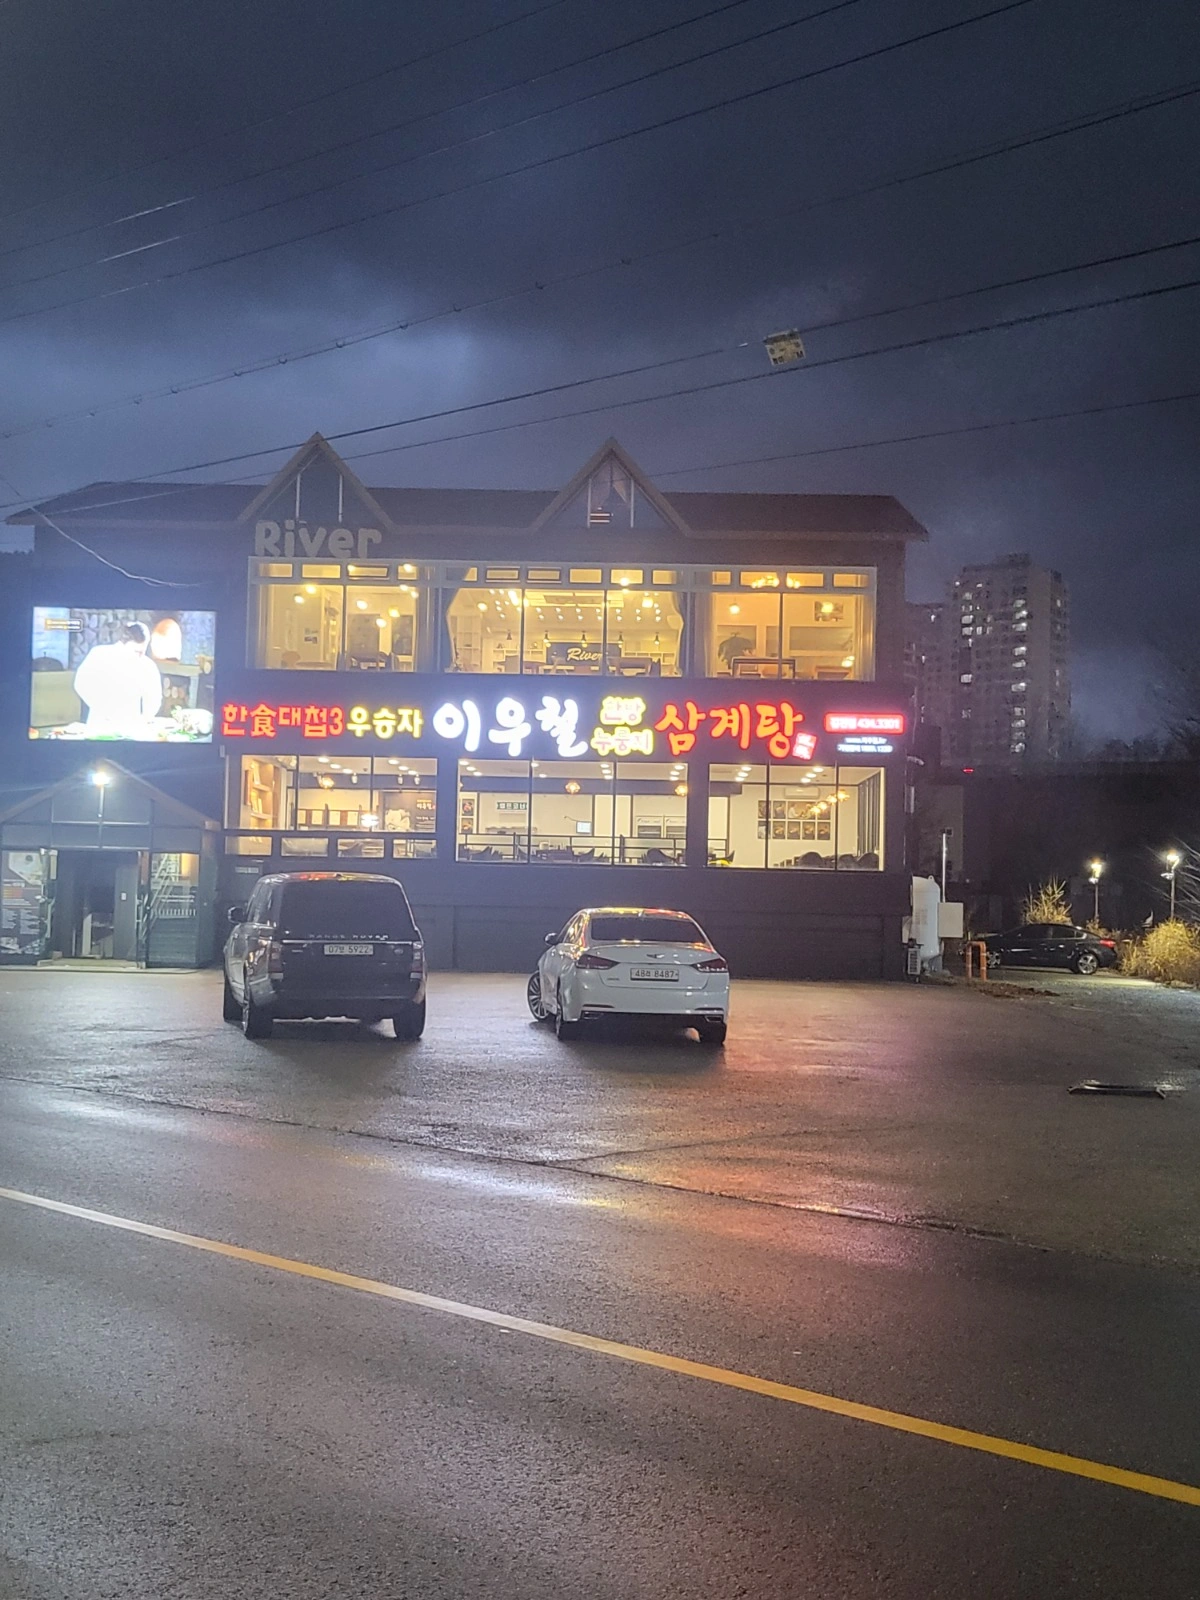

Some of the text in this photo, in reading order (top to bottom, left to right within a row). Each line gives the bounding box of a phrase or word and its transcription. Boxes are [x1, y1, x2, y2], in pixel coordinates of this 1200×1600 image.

[255, 519, 382, 558] River
[222, 703, 424, 739] 한食대첩3 우승자
[600, 696, 646, 725] 한방
[590, 726, 653, 756] 누룽지
[654, 701, 804, 759] 삼계탕
[348, 945, 369, 953] 5922
